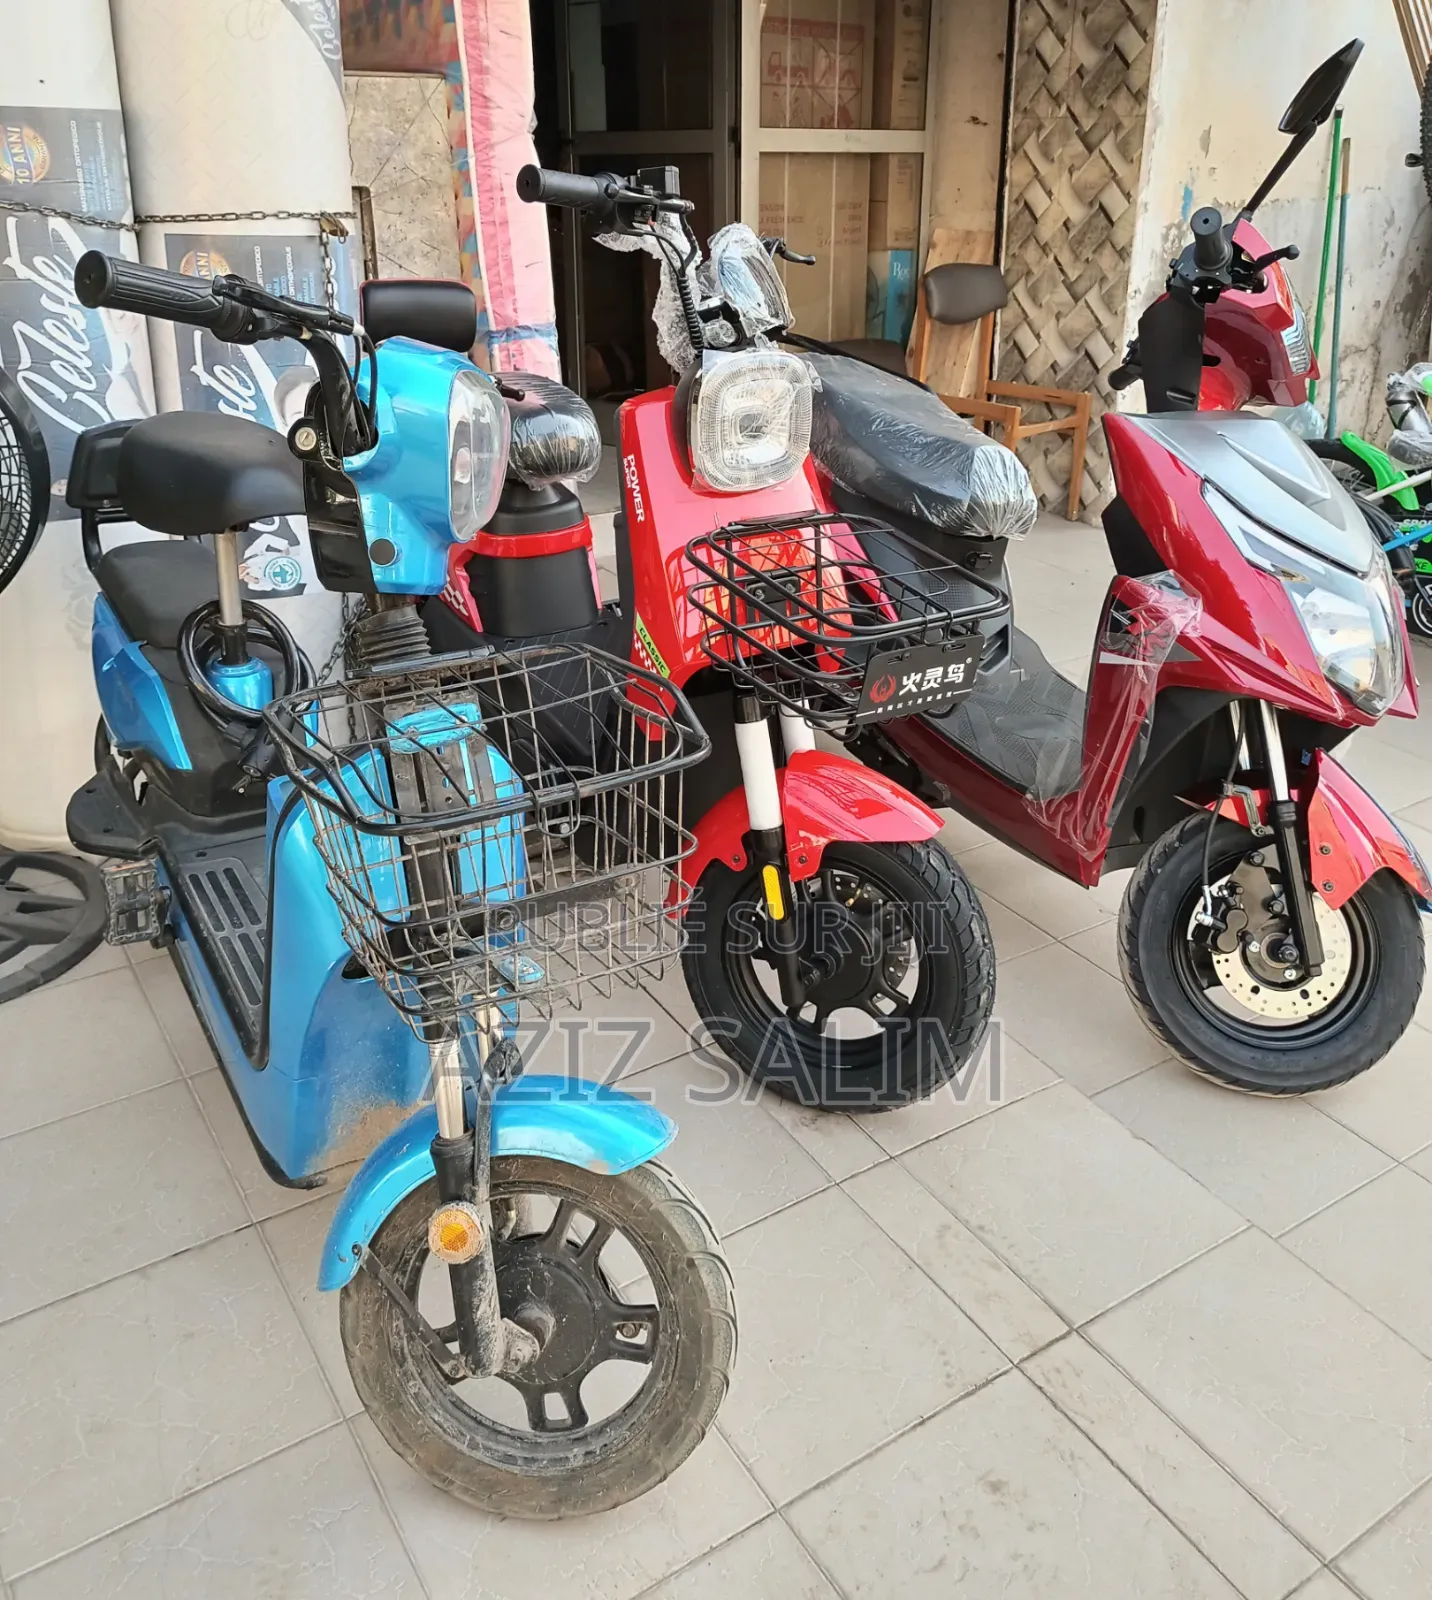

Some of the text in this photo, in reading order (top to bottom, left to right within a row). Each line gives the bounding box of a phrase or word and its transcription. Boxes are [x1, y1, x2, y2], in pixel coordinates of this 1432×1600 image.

[7, 126, 31, 185] 10 ANNI
[2, 216, 112, 435] Celeste
[622, 457, 632, 488] SUPER
[627, 453, 645, 524] POWER
[639, 626, 668, 674] CLASSIC
[898, 663, 967, 697] 火灵鸟
